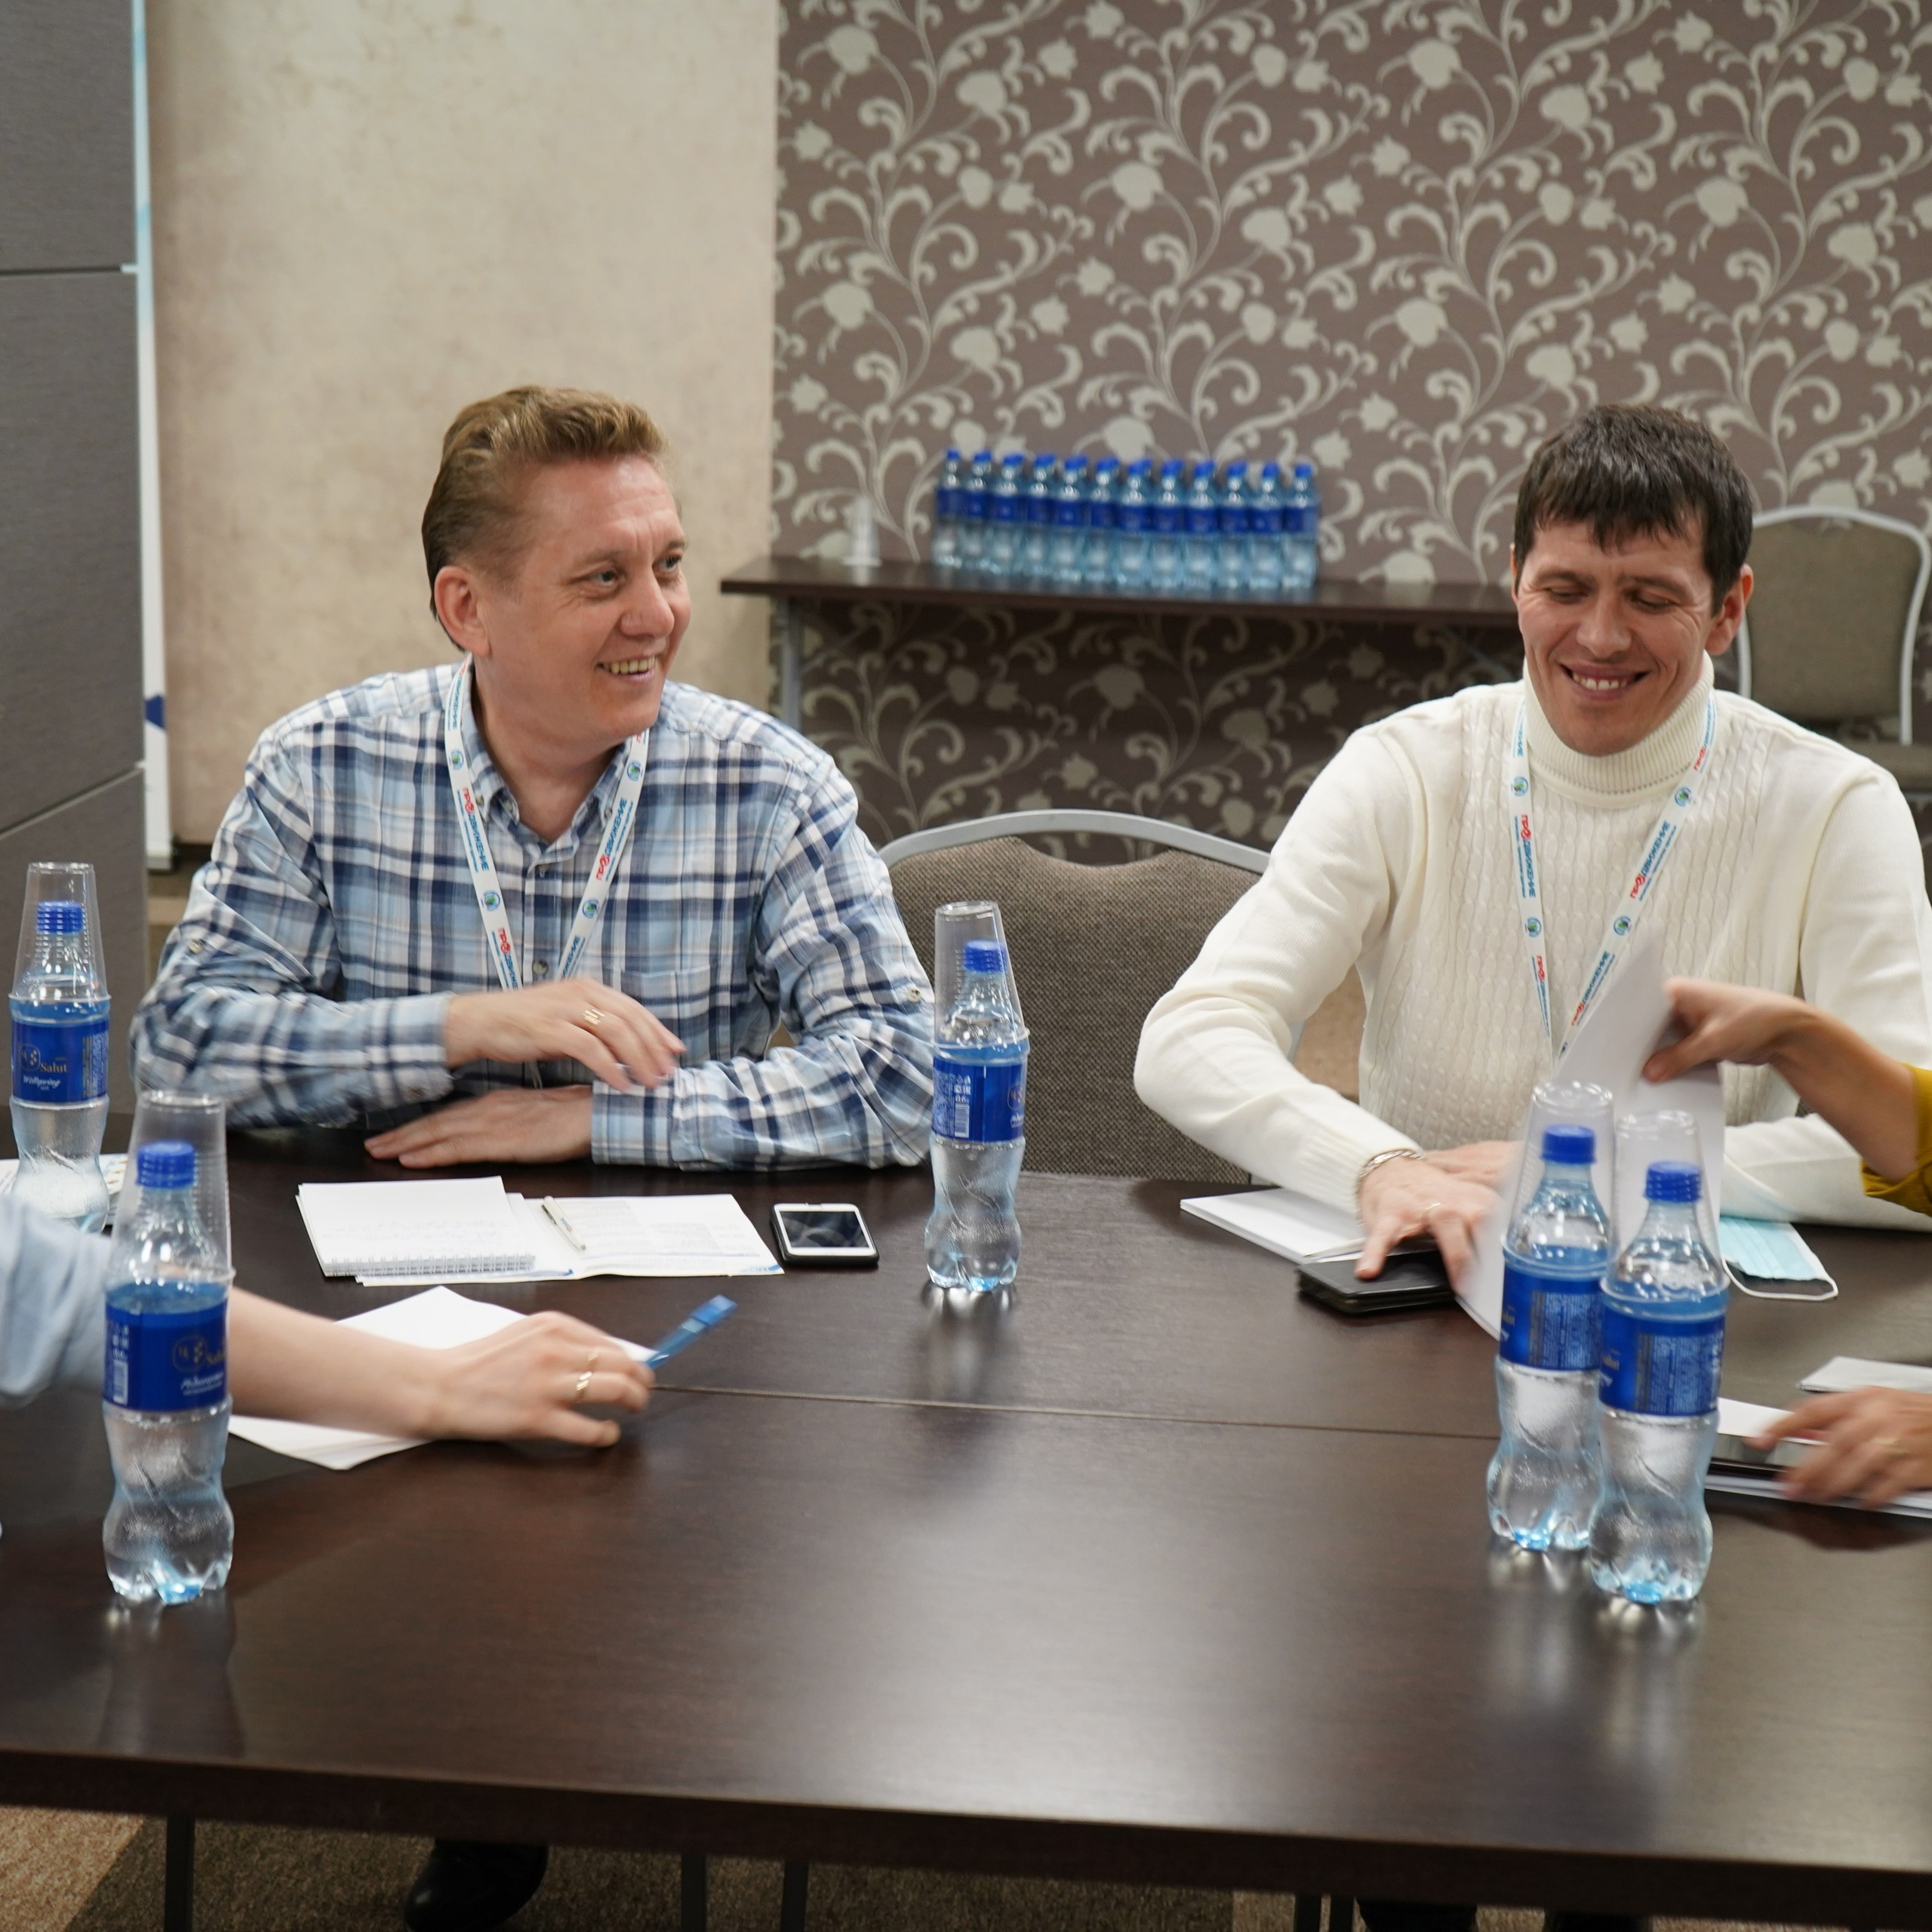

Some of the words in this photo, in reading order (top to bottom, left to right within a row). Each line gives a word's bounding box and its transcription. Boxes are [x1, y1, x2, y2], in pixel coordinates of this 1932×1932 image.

[463, 787, 489, 872] ПРОДВИЖЕНИЕ
[596, 797, 628, 881] ПРОДВИЖЕНИЕ
[1520, 814, 1536, 899] ПРОДВИЖЕНИЕ
[1629, 821, 1671, 900] ПРОДВИЖЕНИЕ
[498, 927, 521, 990] ПРОДВИЖЕ
